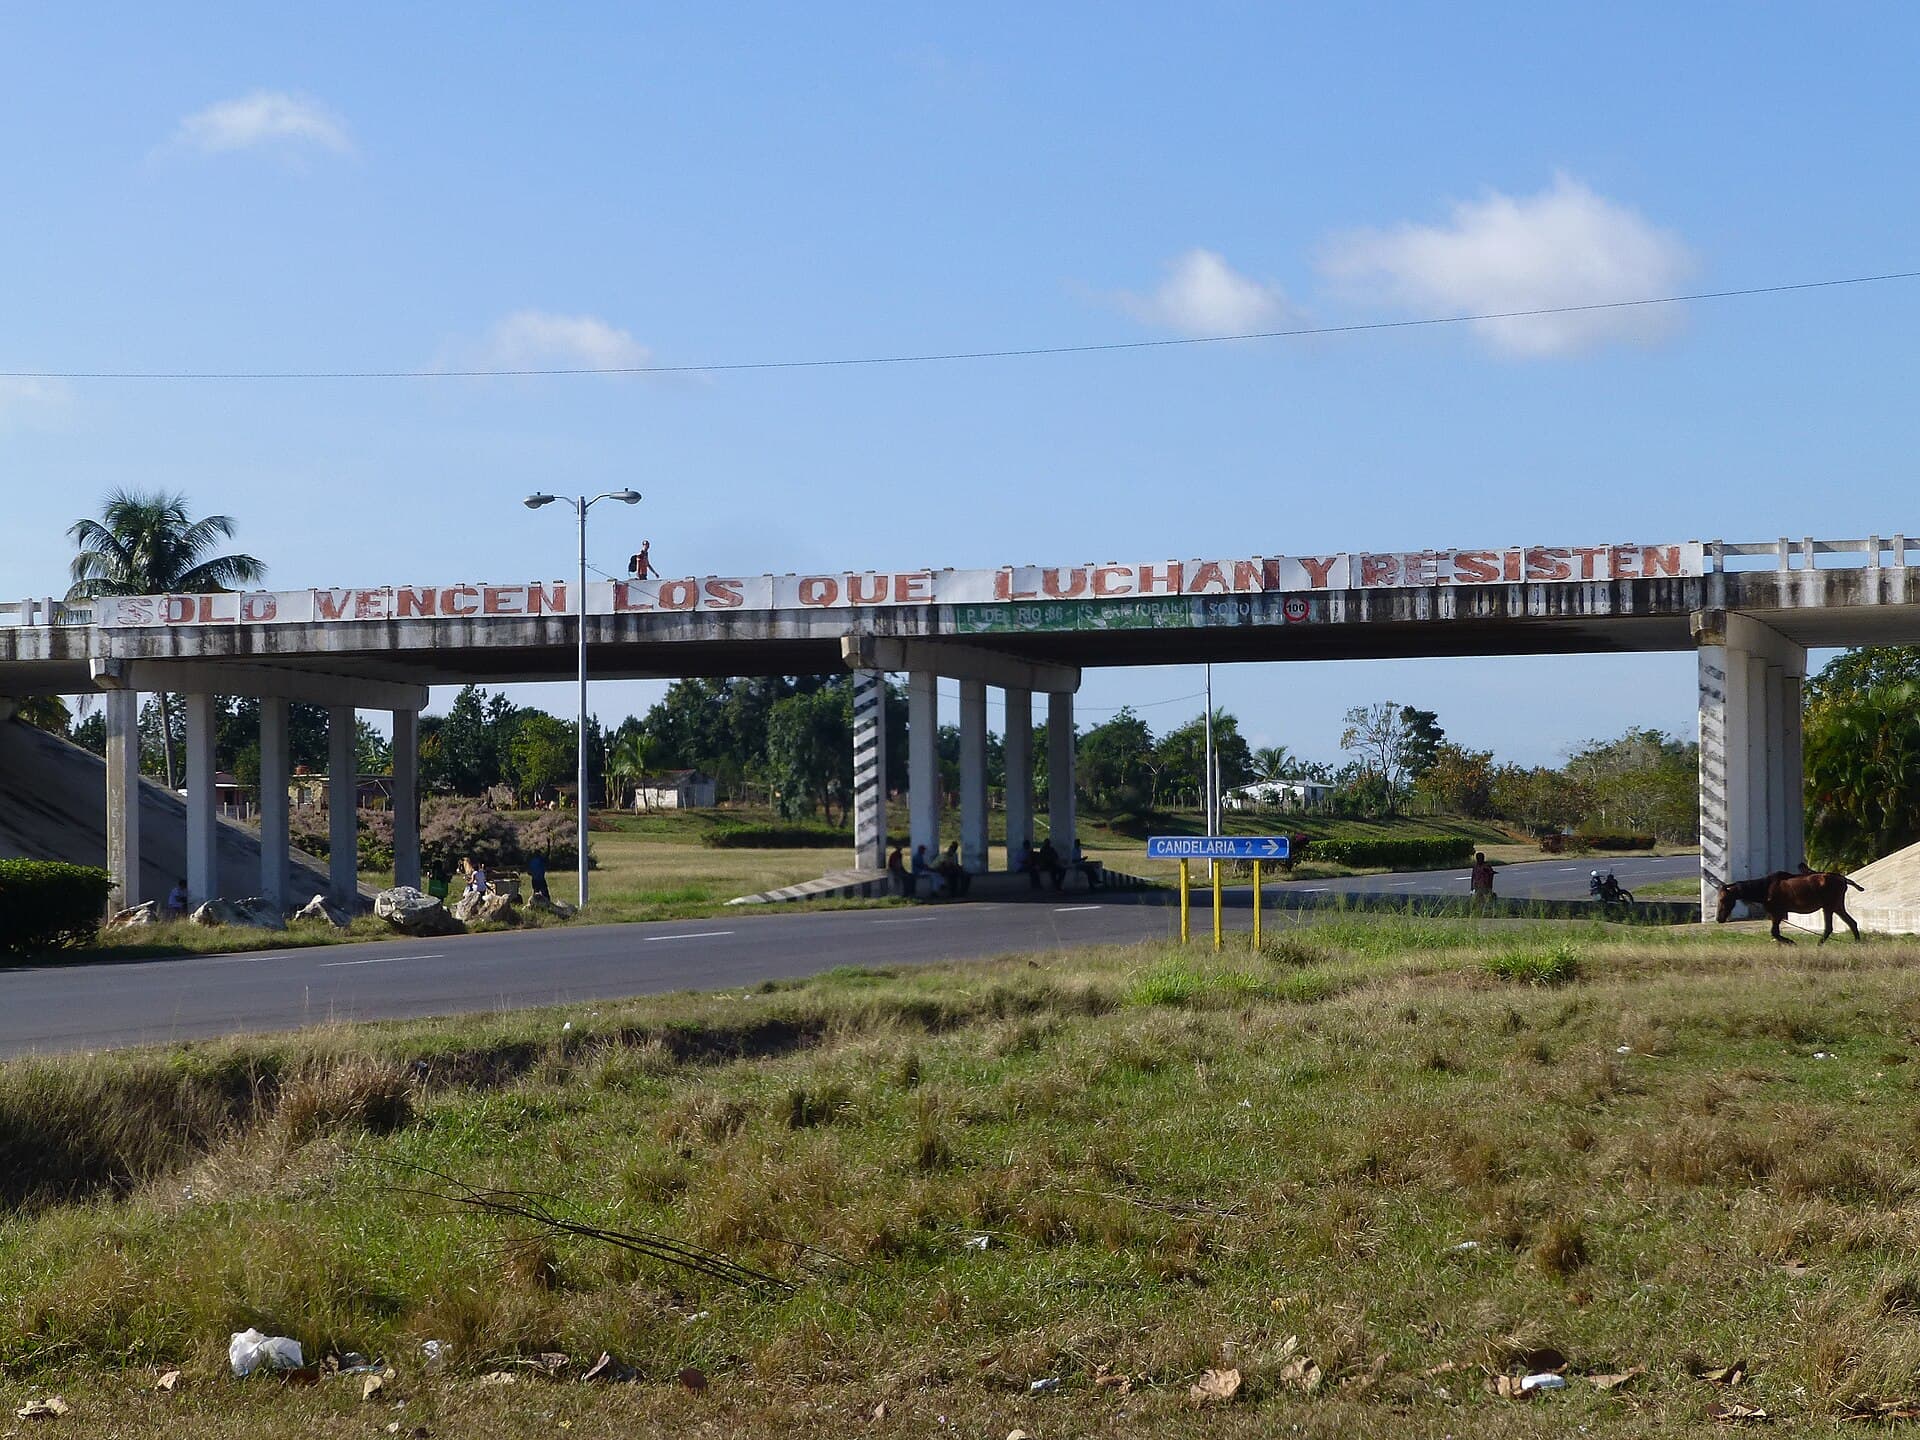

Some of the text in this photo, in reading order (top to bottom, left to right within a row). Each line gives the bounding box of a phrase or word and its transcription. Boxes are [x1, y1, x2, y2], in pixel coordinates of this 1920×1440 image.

[117, 593, 278, 627] SOLO
[315, 585, 567, 620] VENCEN
[613, 579, 744, 613] LOS
[798, 574, 936, 607] QUE
[994, 558, 1281, 601] LUCHAN
[1299, 557, 1338, 590] Y
[1286, 602, 1305, 613] 100
[1156, 840, 1253, 854] CANDELARIA 2
